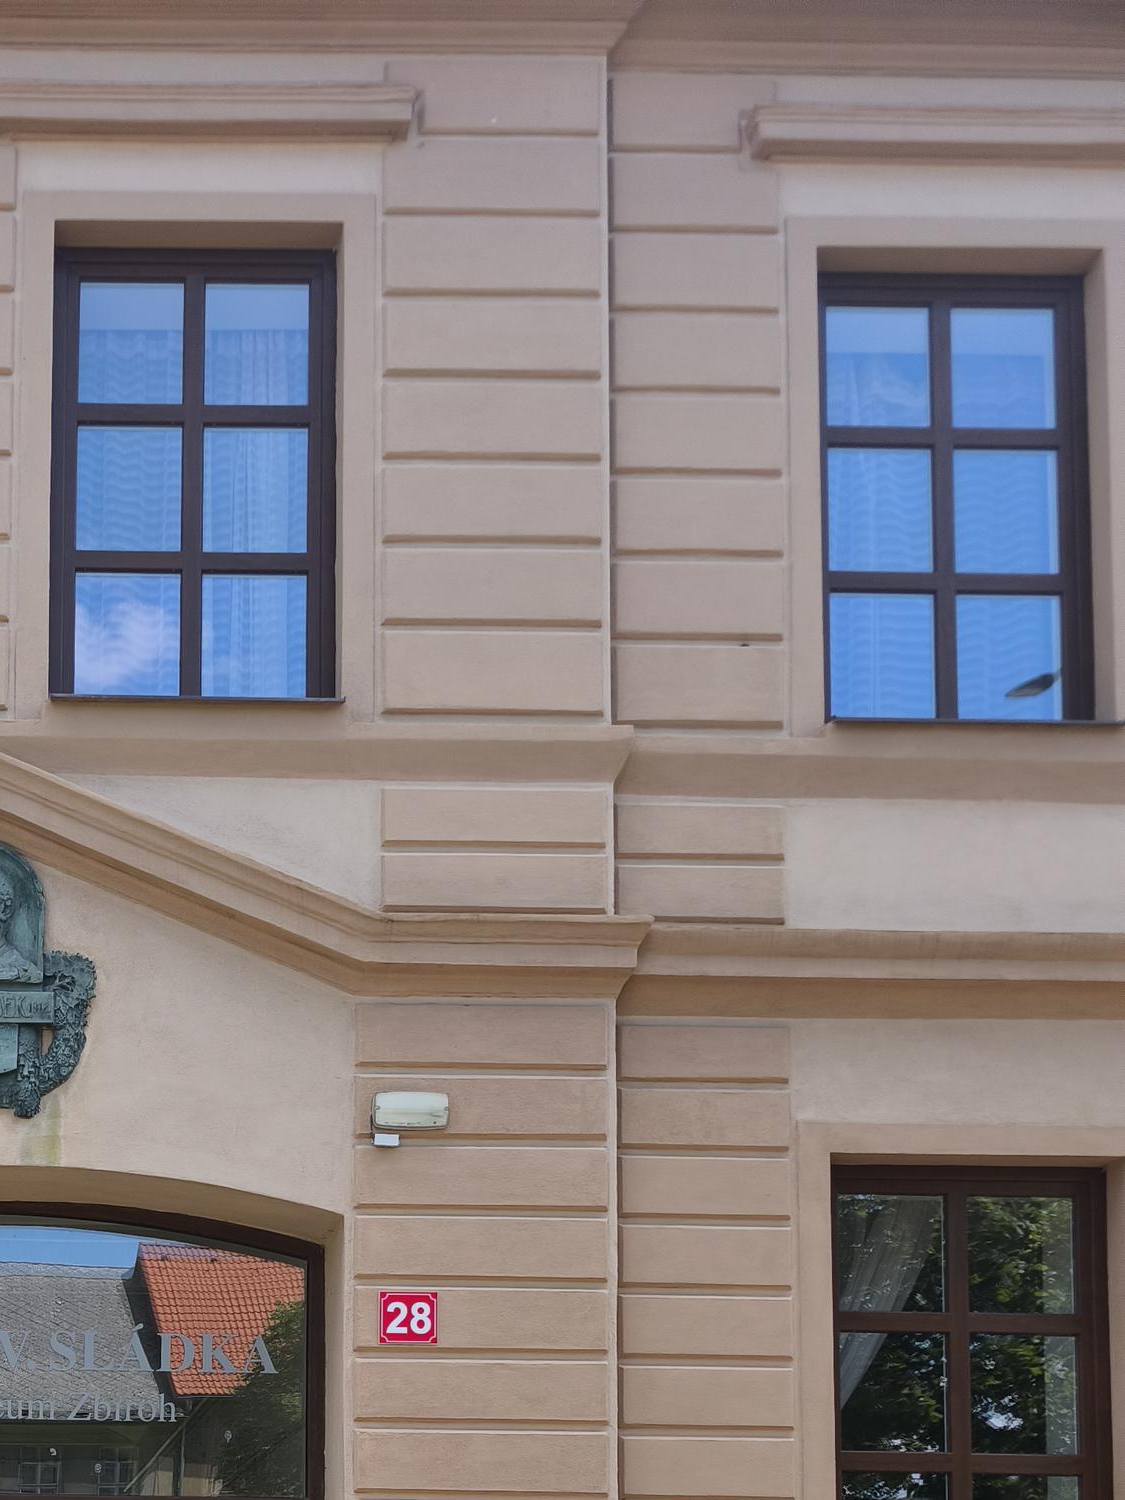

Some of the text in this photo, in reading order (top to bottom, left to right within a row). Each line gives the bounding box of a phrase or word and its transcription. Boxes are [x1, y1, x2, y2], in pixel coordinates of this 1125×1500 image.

[386, 1301, 432, 1335] 28
[48, 1323, 279, 1375] SLÁDKA
[67, 1393, 177, 1423] Zbiroh
